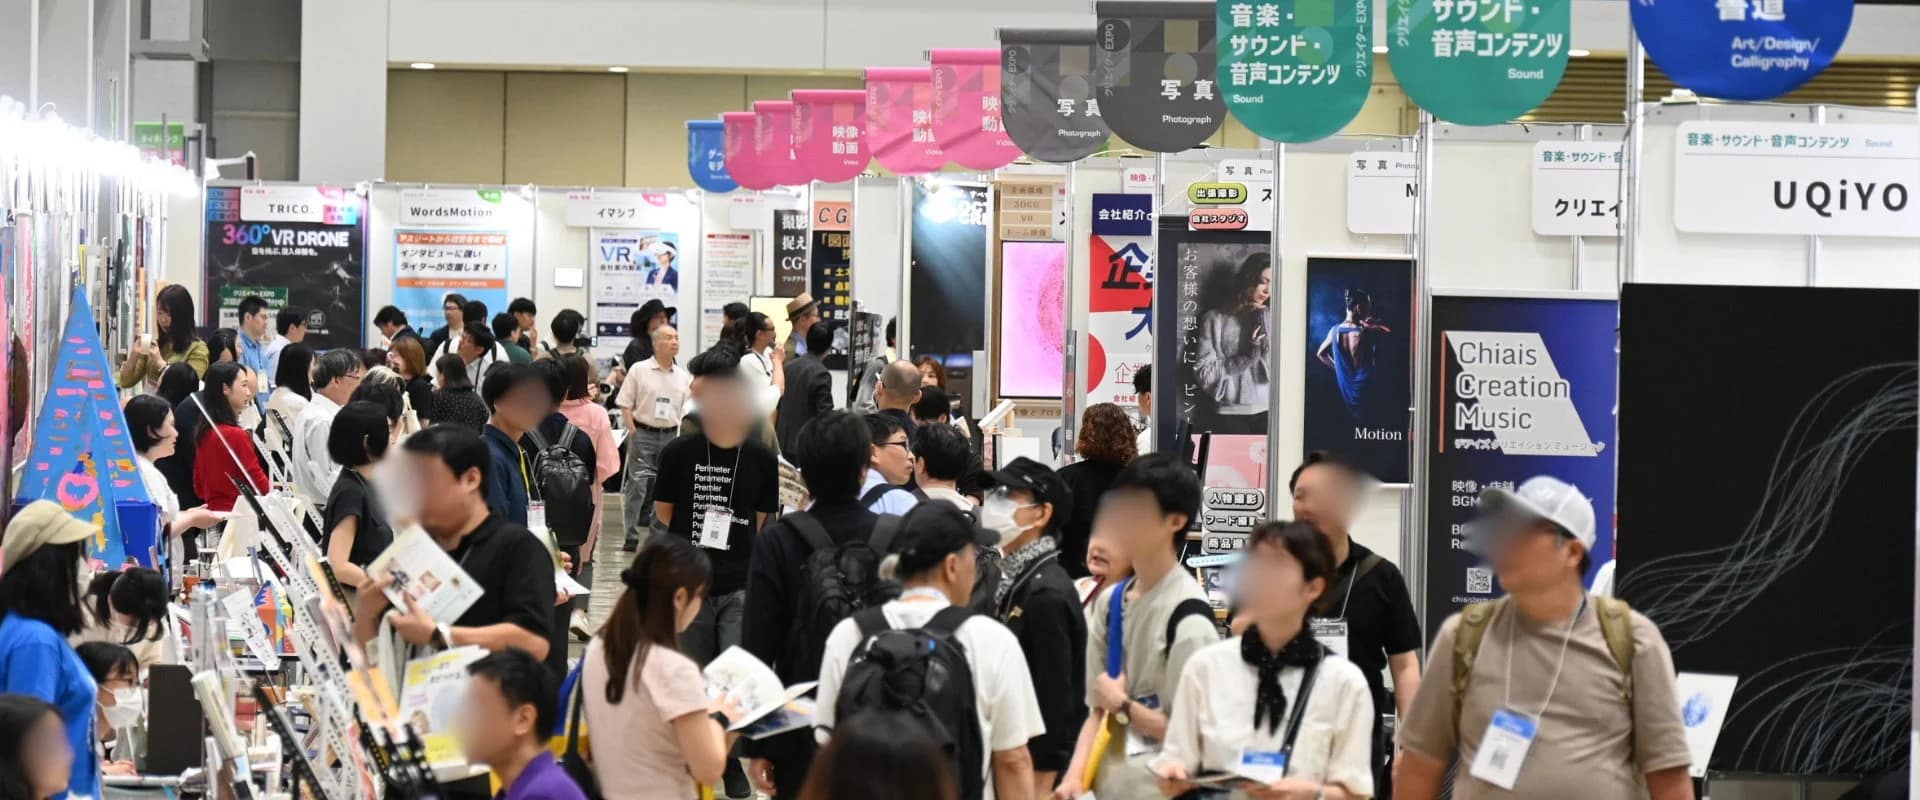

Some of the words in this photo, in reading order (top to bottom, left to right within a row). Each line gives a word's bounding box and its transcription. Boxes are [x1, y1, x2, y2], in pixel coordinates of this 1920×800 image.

[1230, 3, 1294, 27] 音楽・
[1432, 0, 1540, 23] サウンド・
[1230, 34, 1320, 56] サウンド・
[1355, 0, 1367, 78] クリエイターEXP
[1432, 28, 1563, 57] 音声コンテンツ
[1731, 36, 1820, 53] Art/Design/
[1731, 54, 1810, 71] Calligraphy
[1230, 61, 1340, 86] 音声コンテンツ
[1508, 68, 1544, 79] Sound
[1161, 80, 1214, 100] 写真
[982, 96, 1001, 112] 映
[1232, 94, 1264, 104] Sound
[912, 109, 931, 124] 映
[1162, 114, 1212, 127] Photograph
[1058, 128, 1101, 138] Photograph
[1687, 132, 1850, 149] 音楽・サウンド・音声コンテンツ
[832, 142, 858, 154] 動画
[1356, 159, 1387, 170] 写真
[1130, 173, 1155, 182] 映像・
[1197, 188, 1239, 199] 出張撮影
[1773, 179, 1909, 218] UQiYO
[410, 206, 493, 217] WordsMotion
[1554, 198, 1623, 217] クリエイ
[223, 224, 271, 245] 360°
[271, 229, 295, 246] VR
[297, 231, 349, 248] DRONE
[782, 256, 807, 270] CG
[1459, 342, 1537, 365] Chiais
[1459, 374, 1568, 397] Creation
[1459, 405, 1532, 429] Music
[1354, 427, 1402, 440] Motion
[695, 464, 731, 474] Perimeter
[694, 474, 732, 484] Parameter
[694, 484, 722, 492] Premier
[1208, 537, 1247, 549] 商品撮
